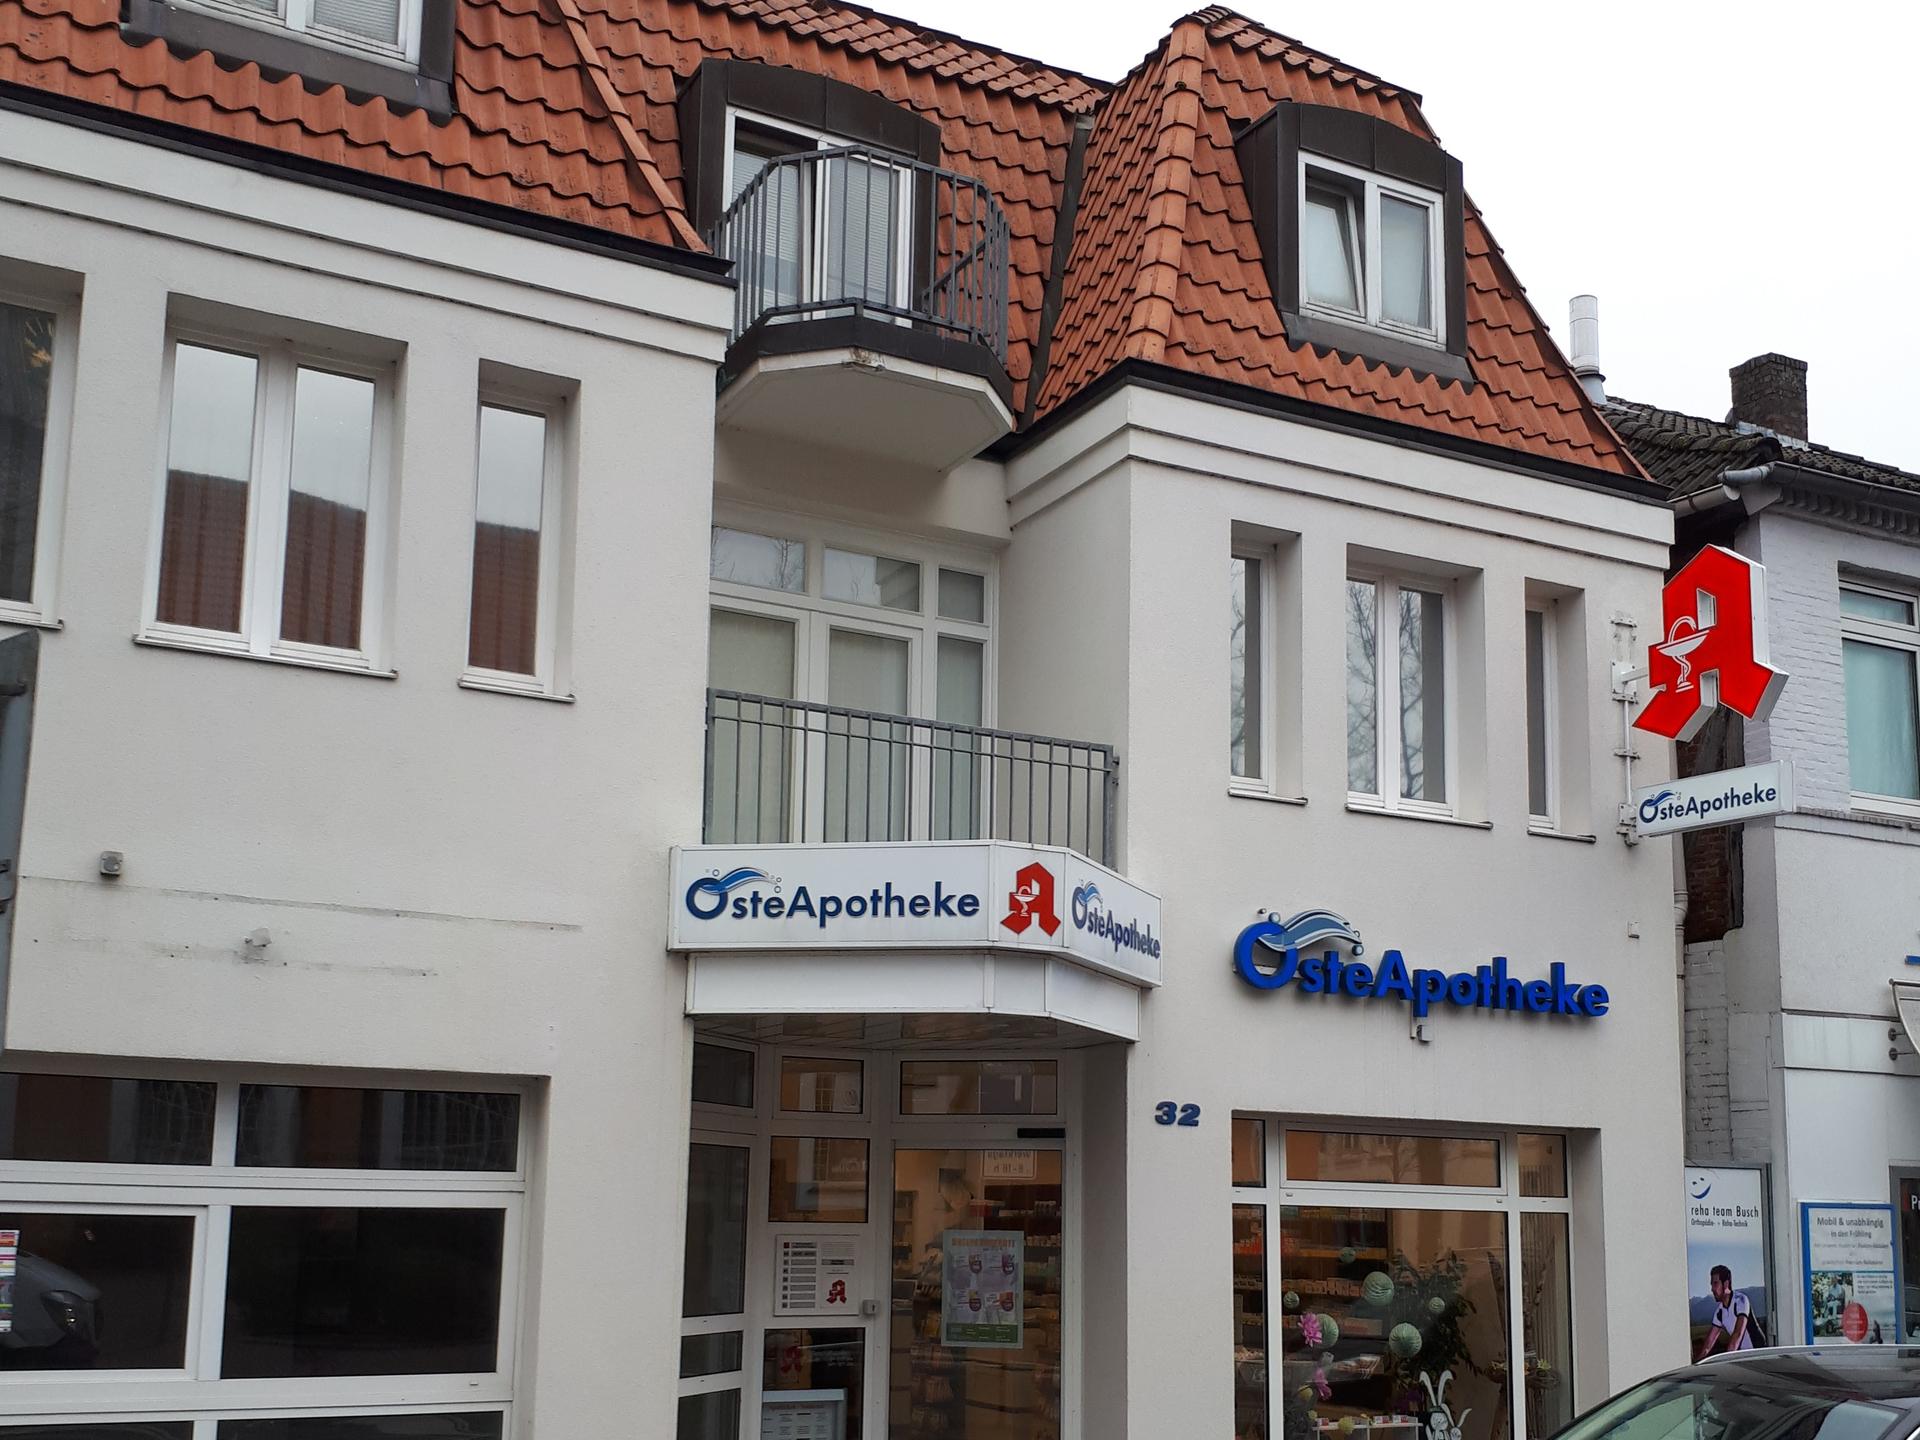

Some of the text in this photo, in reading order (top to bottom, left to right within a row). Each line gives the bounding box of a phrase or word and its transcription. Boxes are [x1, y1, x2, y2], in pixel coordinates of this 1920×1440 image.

[1639, 783, 1777, 823] OsteApotheke
[685, 875, 981, 927] OsteApotheke
[1071, 884, 1161, 960] OsteApotheke
[1233, 920, 1610, 1017] OsteApotheke
[1154, 1101, 1201, 1127] 32
[1691, 1204, 1759, 1218] reha team Busch
[1817, 1217, 1837, 1226] Mobil
